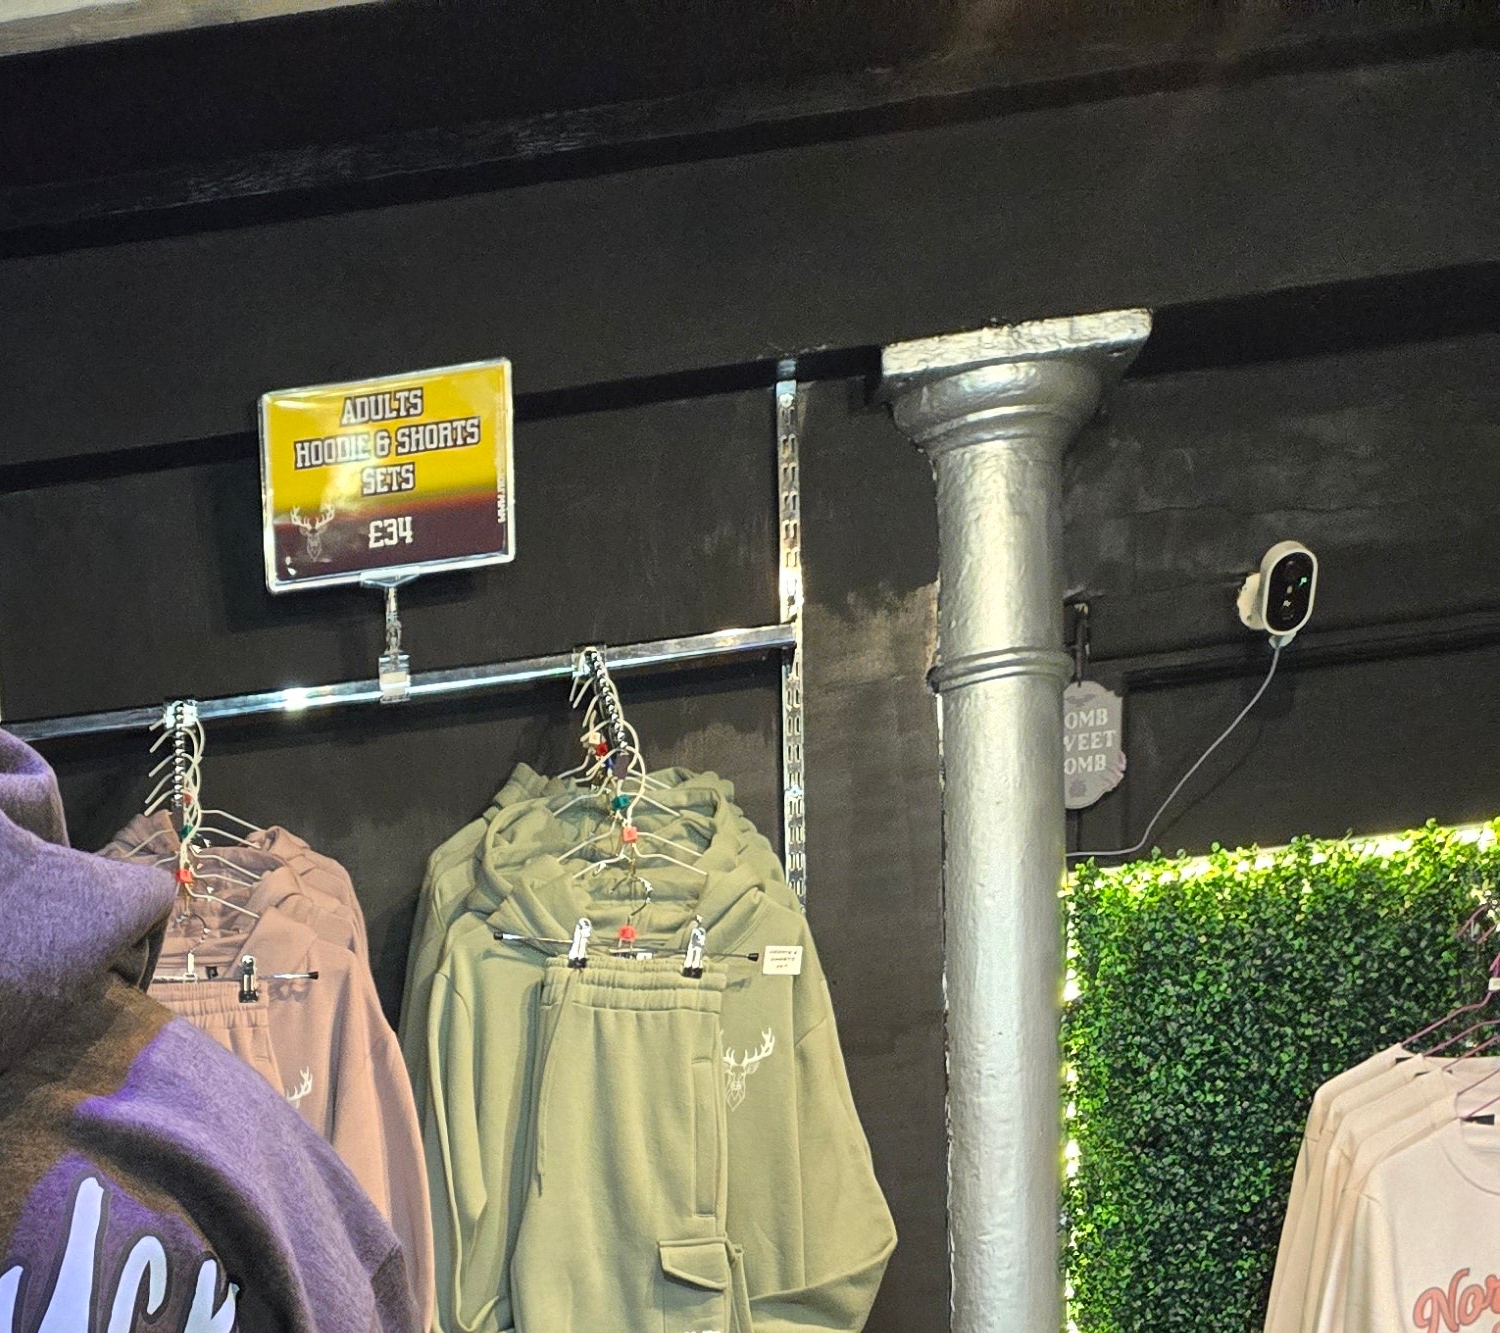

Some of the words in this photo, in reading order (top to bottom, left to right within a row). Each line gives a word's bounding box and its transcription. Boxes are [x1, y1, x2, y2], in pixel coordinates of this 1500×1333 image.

[341, 387, 424, 426] ADULTS
[295, 434, 374, 470] HOODIE
[375, 429, 391, 458] &
[396, 416, 482, 456] SHORTS
[361, 462, 416, 497] SETS
[368, 516, 414, 549] £34
[1063, 708, 1109, 730] OMB
[1063, 754, 1107, 775] OMB
